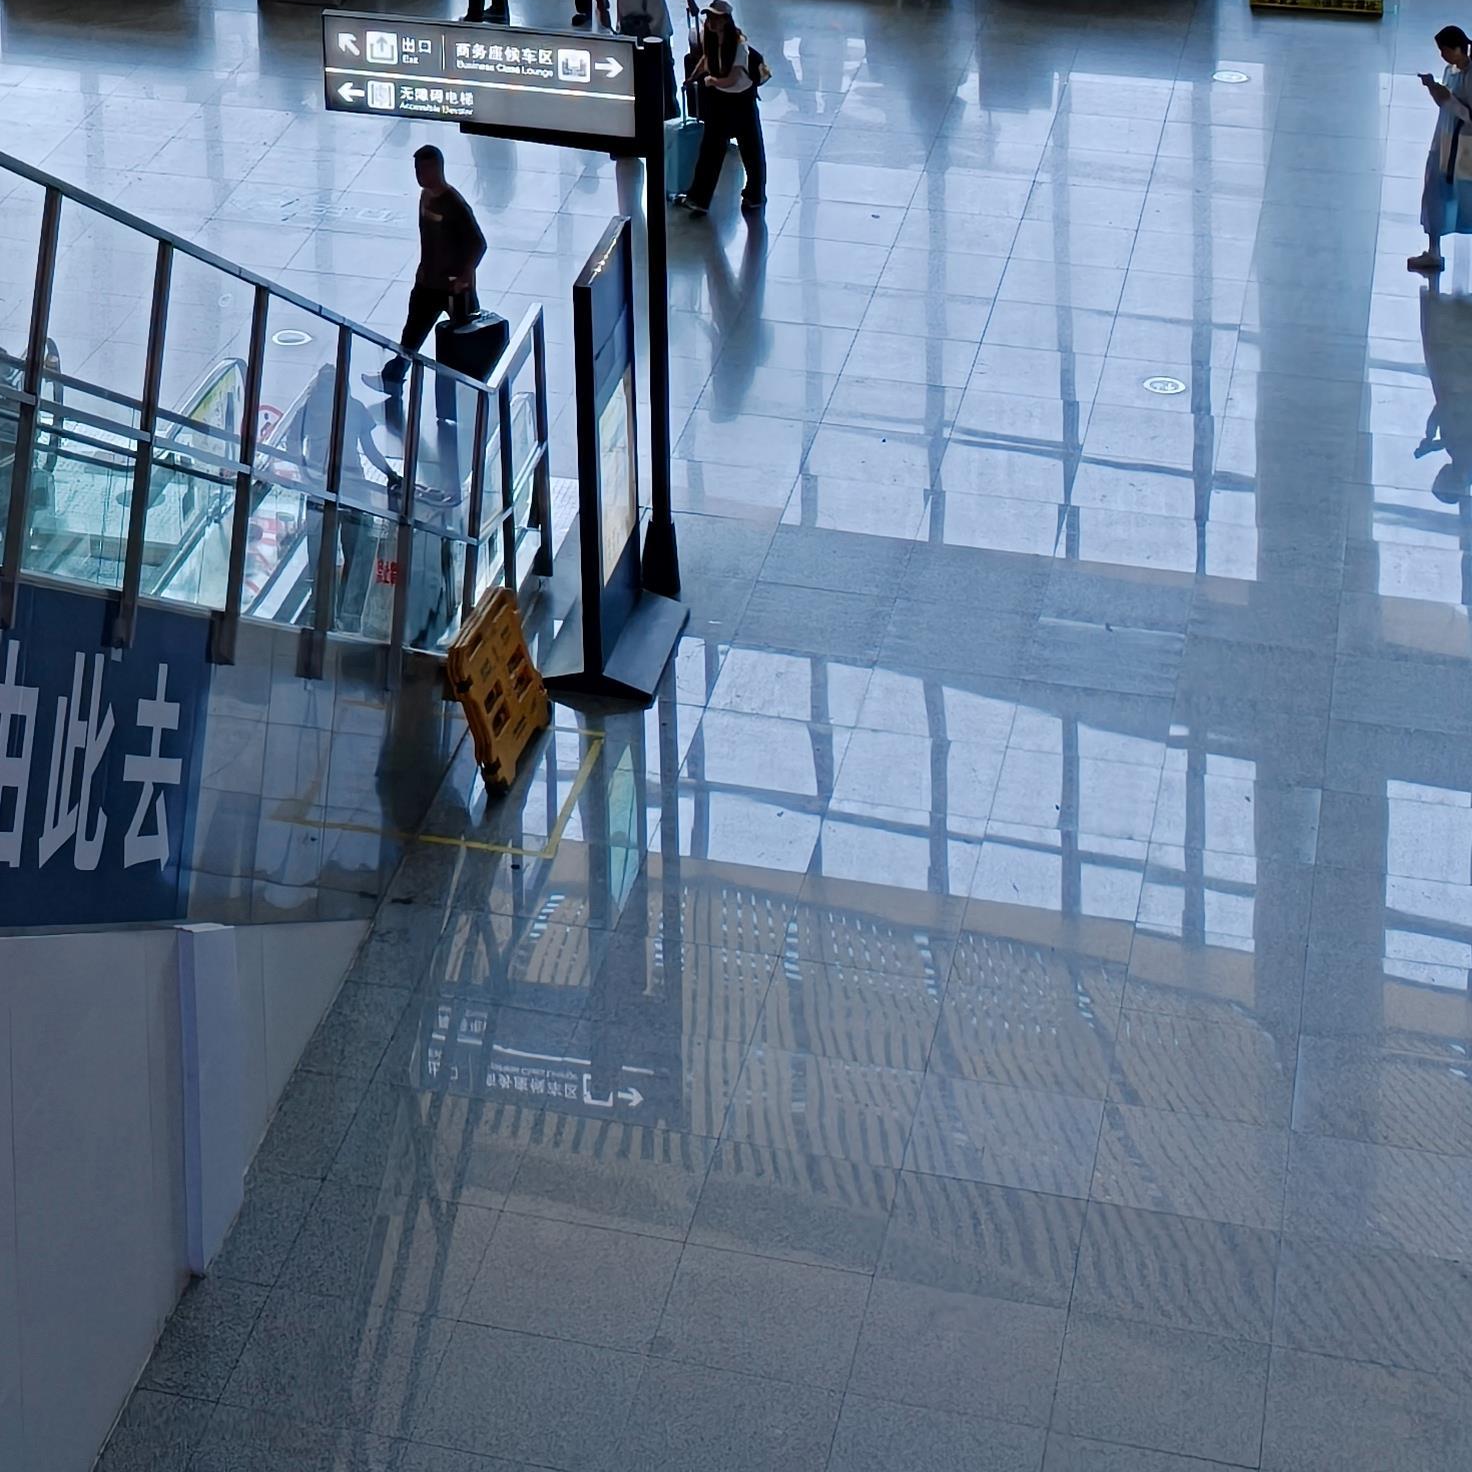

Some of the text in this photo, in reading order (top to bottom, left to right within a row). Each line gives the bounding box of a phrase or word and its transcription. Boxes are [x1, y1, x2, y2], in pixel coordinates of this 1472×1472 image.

[401, 36, 432, 54] 出口
[455, 42, 554, 66] 商务座候车区
[399, 85, 474, 106] 无障碍电梯
